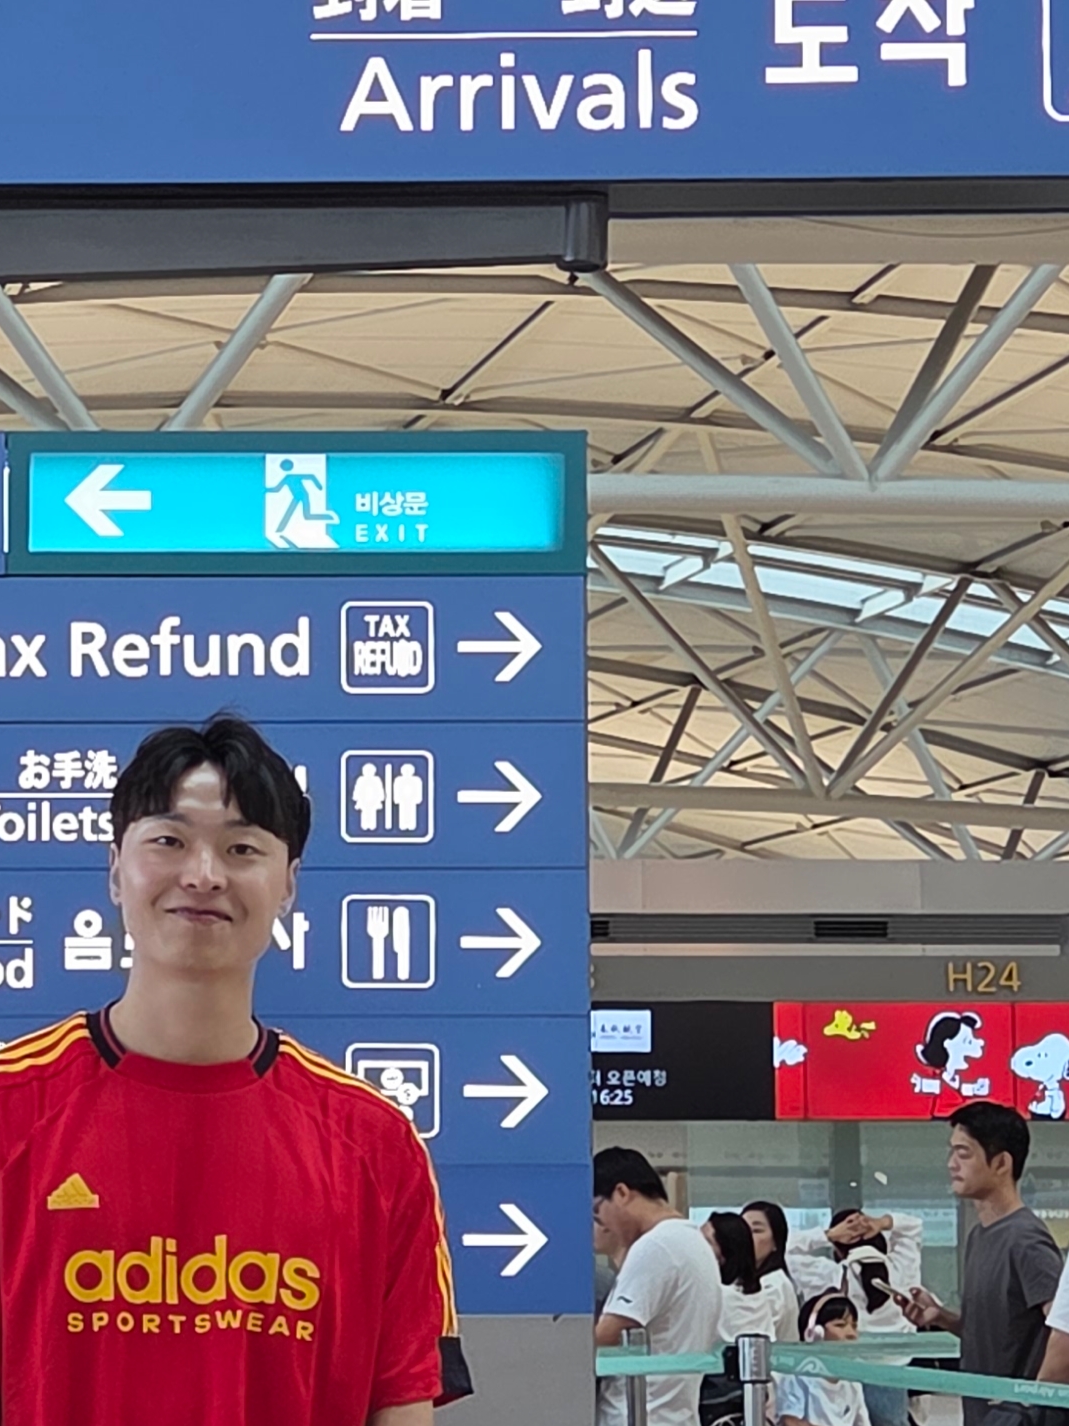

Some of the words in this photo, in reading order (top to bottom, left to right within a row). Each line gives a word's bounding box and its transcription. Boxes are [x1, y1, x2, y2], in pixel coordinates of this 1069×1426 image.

[765, 0, 976, 87] 도착
[340, 48, 700, 132] Arrivals
[355, 490, 429, 517] 비상문
[355, 523, 429, 544] EXIT
[70, 616, 310, 678] Refund
[363, 614, 412, 638] TAX
[64, 908, 135, 971] 음
[947, 960, 1022, 993] H24
[64, 1234, 321, 1311] adidas
[67, 1309, 315, 1341] SPORTSWEAR
